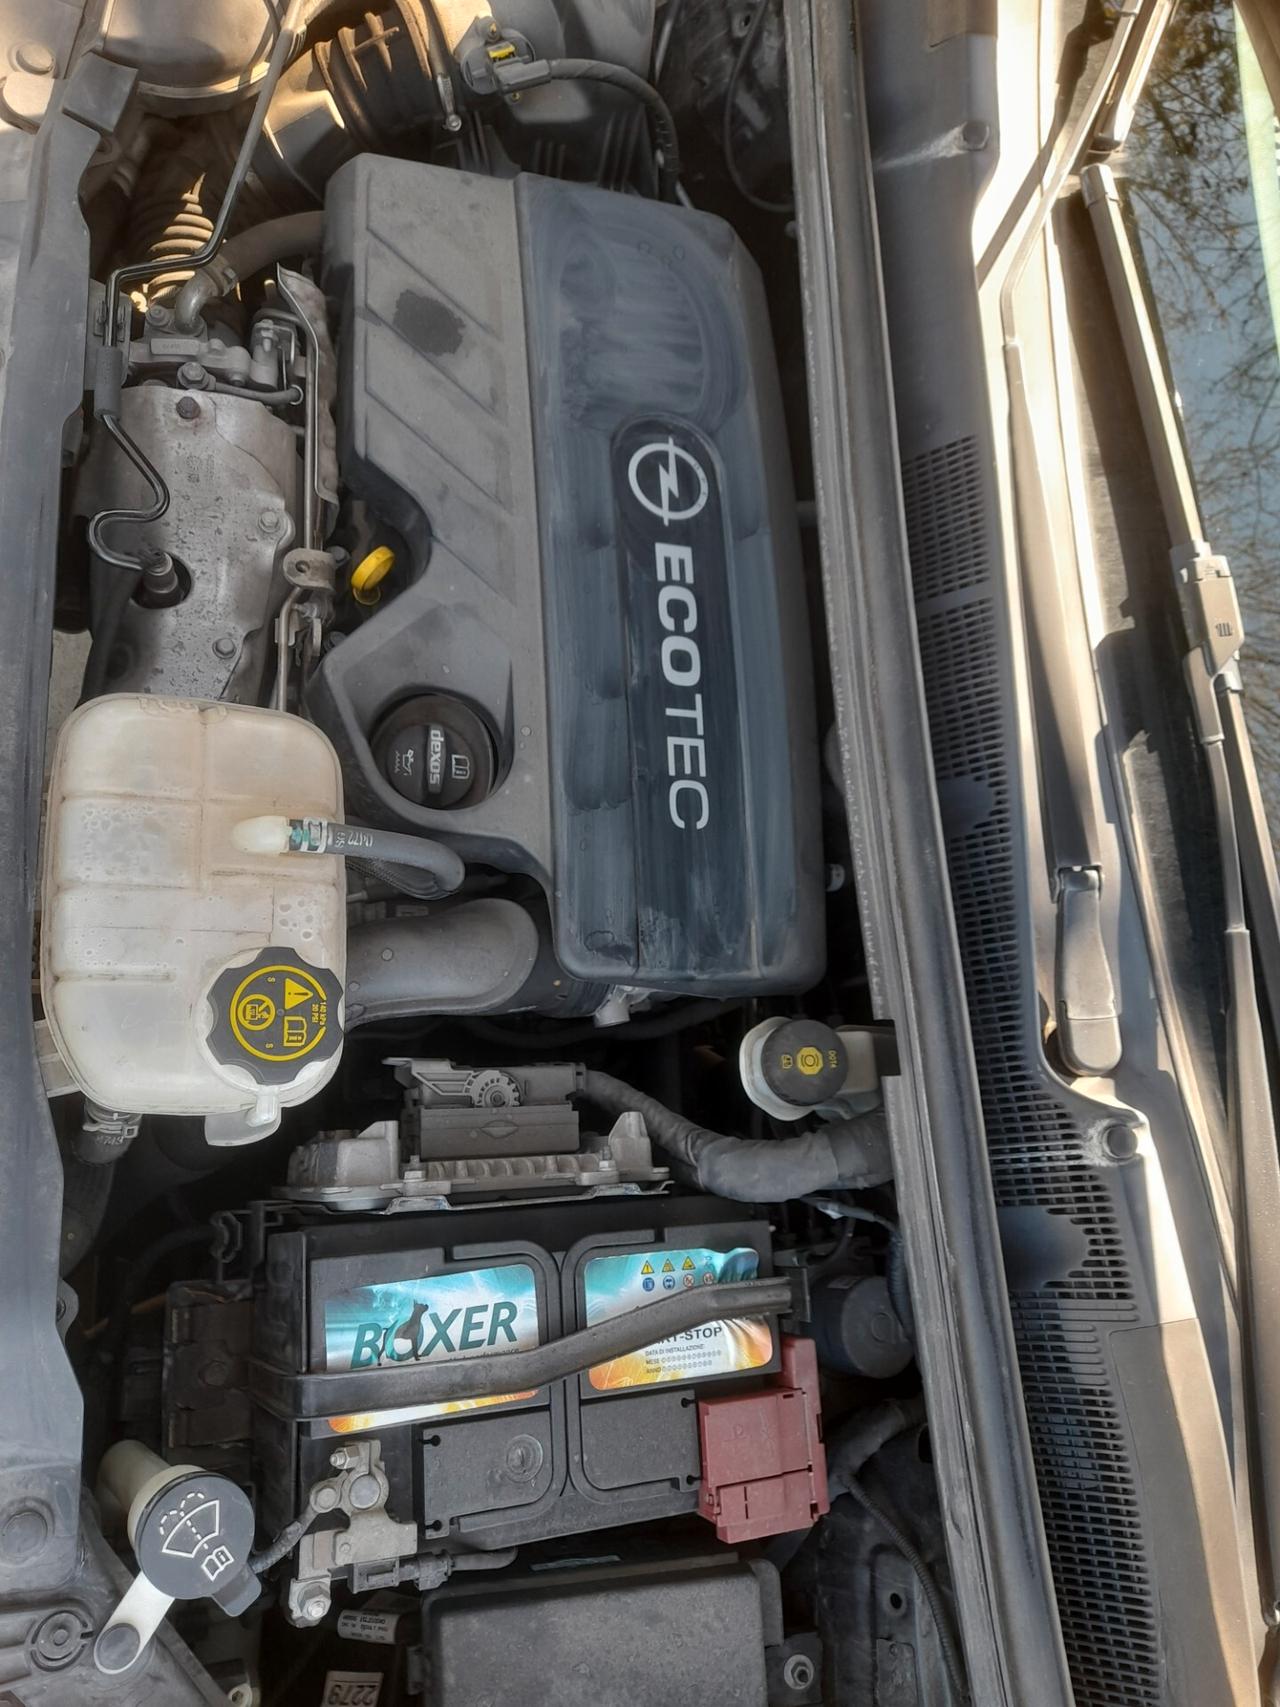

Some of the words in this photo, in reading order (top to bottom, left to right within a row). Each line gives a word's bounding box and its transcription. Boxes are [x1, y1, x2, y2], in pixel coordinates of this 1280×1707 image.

[654, 542, 709, 830] ECOTEC
[430, 729, 444, 785] dexos
[311, 1003, 319, 1012] 20
[319, 1001, 327, 1013] 140
[311, 1012, 319, 1023] PSI
[319, 1013, 327, 1026] kPa
[351, 1301, 518, 1369] BOXER
